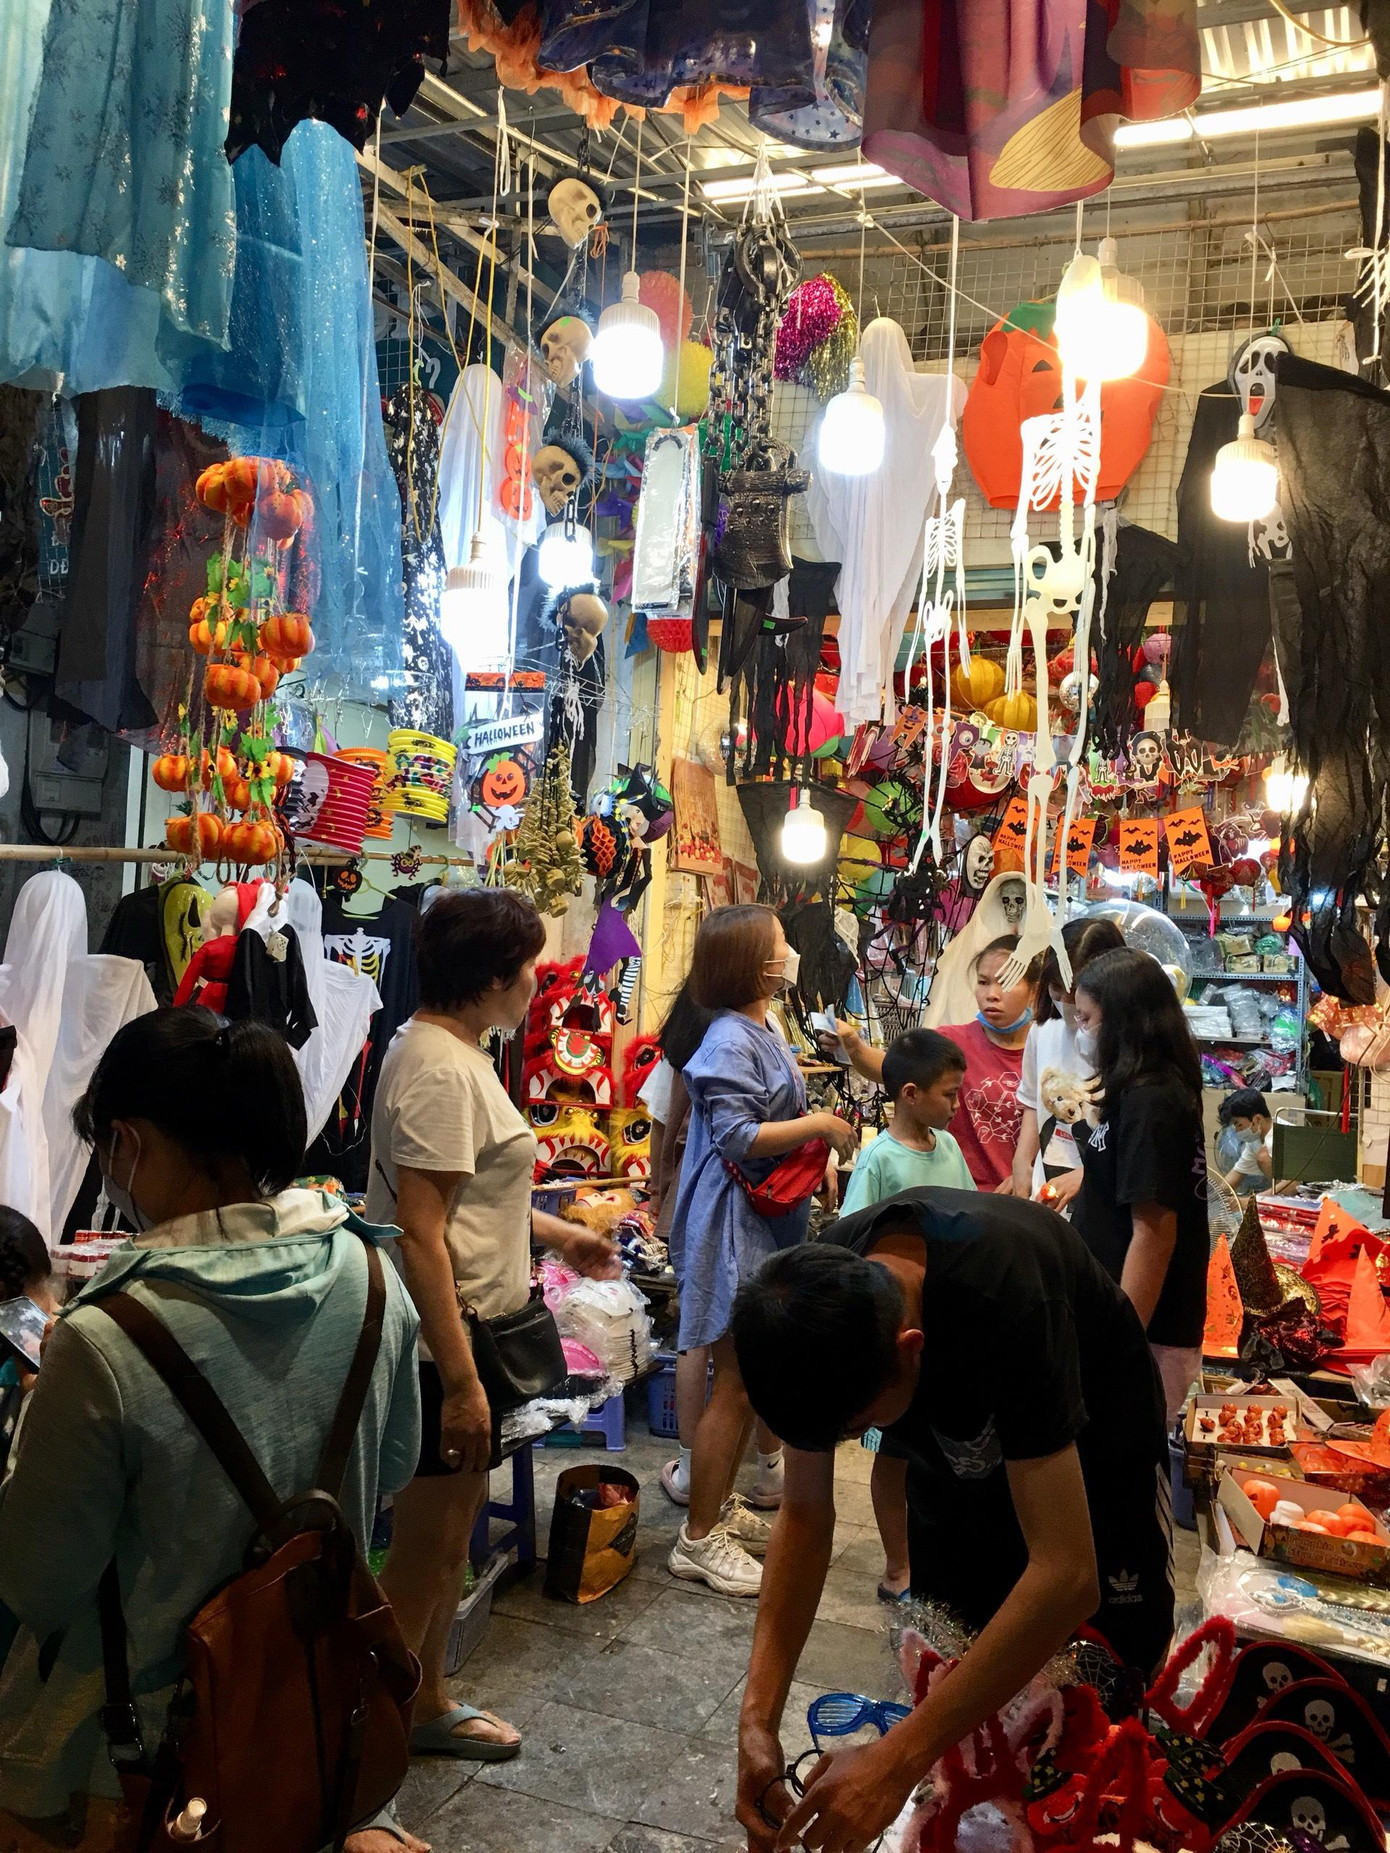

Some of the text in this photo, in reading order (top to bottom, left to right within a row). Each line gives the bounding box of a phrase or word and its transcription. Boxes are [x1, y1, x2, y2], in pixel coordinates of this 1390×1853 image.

[474, 722, 535, 747] HALLOWEEN
[1000, 834, 1017, 842] HAPPY
[998, 839, 1024, 851] HALLOWEE
[1173, 849, 1194, 859] HAPPY
[1174, 850, 1210, 865] HALLOWEEN
[1108, 1594, 1143, 1604] adidas
